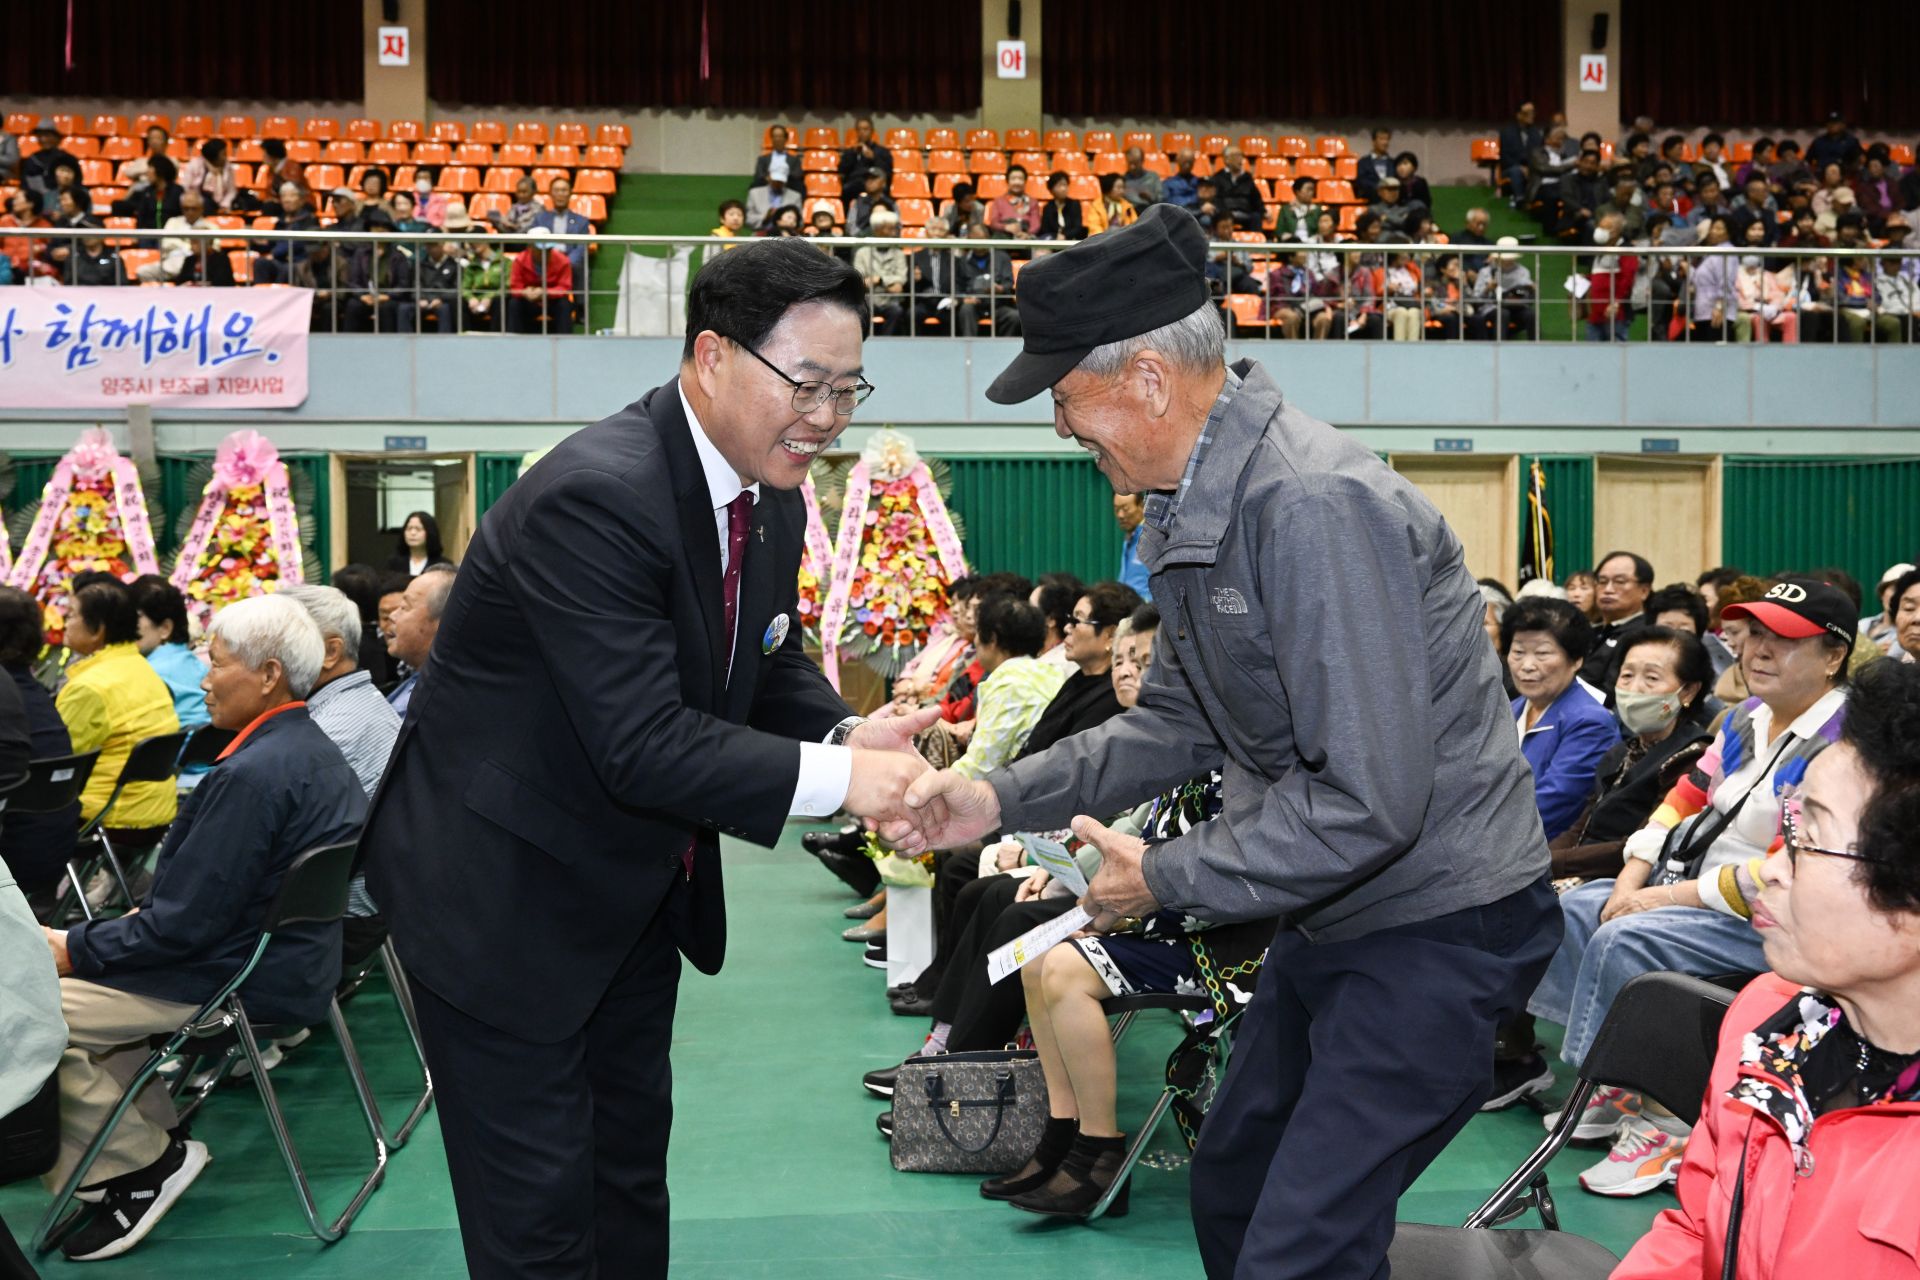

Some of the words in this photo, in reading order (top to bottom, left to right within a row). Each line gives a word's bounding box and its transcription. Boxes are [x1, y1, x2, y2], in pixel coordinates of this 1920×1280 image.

[383, 35, 404, 57] 자
[1001, 48, 1022, 71] 아
[1584, 62, 1604, 84] 사
[46, 303, 278, 370] 함께해요.
[101, 378, 151, 394] 양주시
[160, 378, 209, 394] 보조금
[217, 378, 284, 394] 지원사업
[1214, 588, 1230, 597] THE
[1764, 583, 1807, 602] SD
[1216, 604, 1234, 613] FACE
[131, 1190, 155, 1200] PUMA
